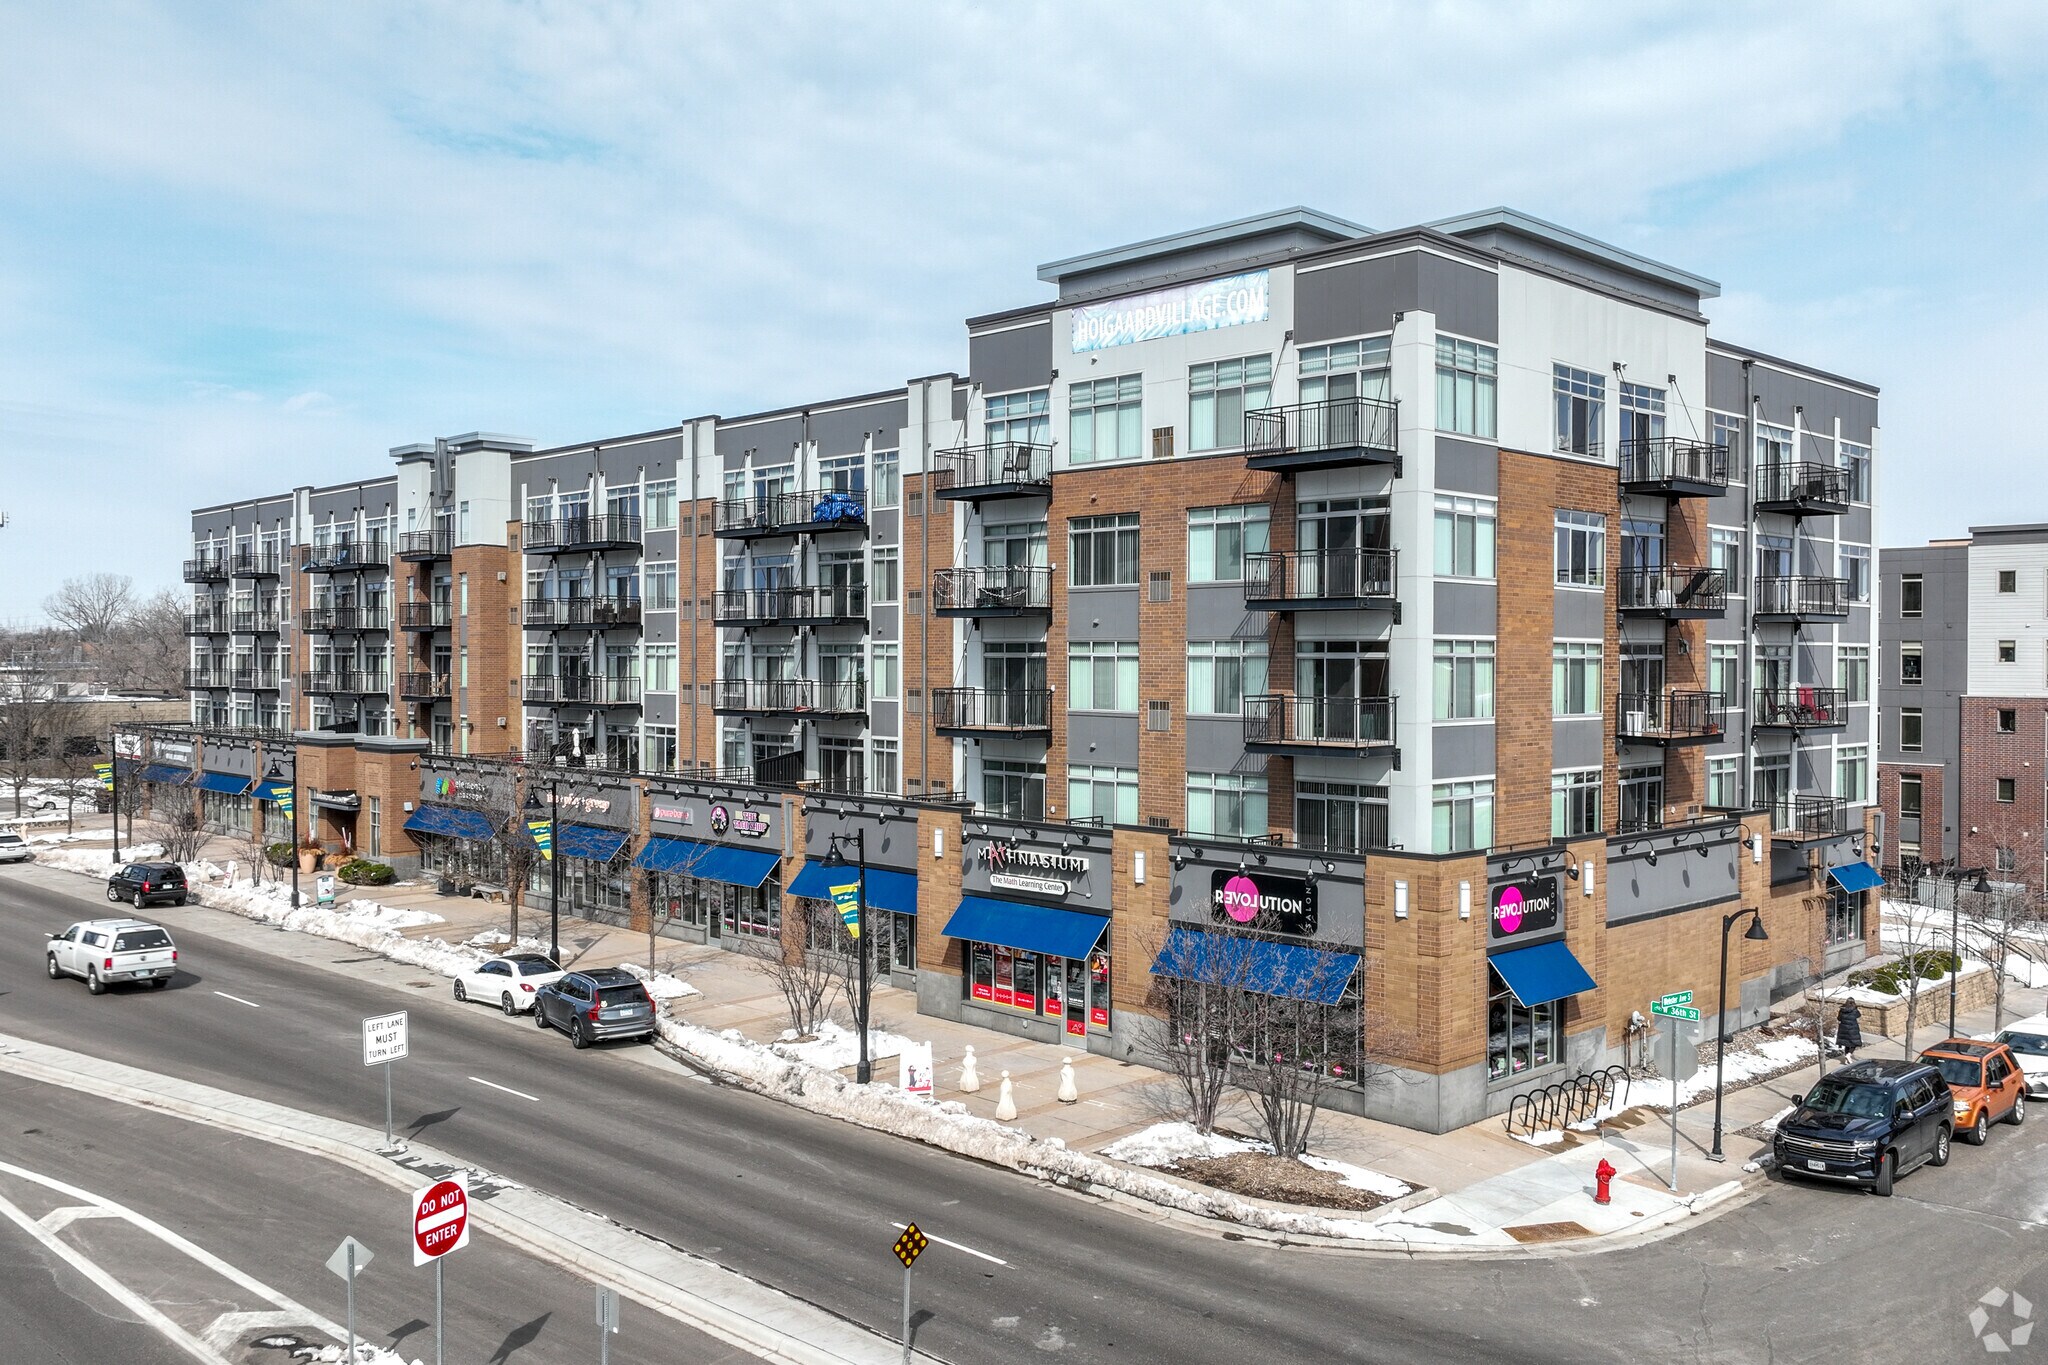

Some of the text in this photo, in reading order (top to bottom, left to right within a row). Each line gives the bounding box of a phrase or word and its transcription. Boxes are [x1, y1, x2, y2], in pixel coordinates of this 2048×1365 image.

[1077, 286, 1265, 342] HOIGAARDVILLAGE.COM
[992, 875, 1063, 892] The Math Learning Center
[1670, 1007, 1687, 1017] 36th
[1689, 1010, 1697, 1019] St
[367, 1017, 403, 1032] LEFT LANE
[375, 1031, 397, 1044] MUST
[369, 1043, 404, 1058] TURN LEFT
[421, 1188, 461, 1215] DO NOT
[425, 1223, 458, 1247] ENTER
